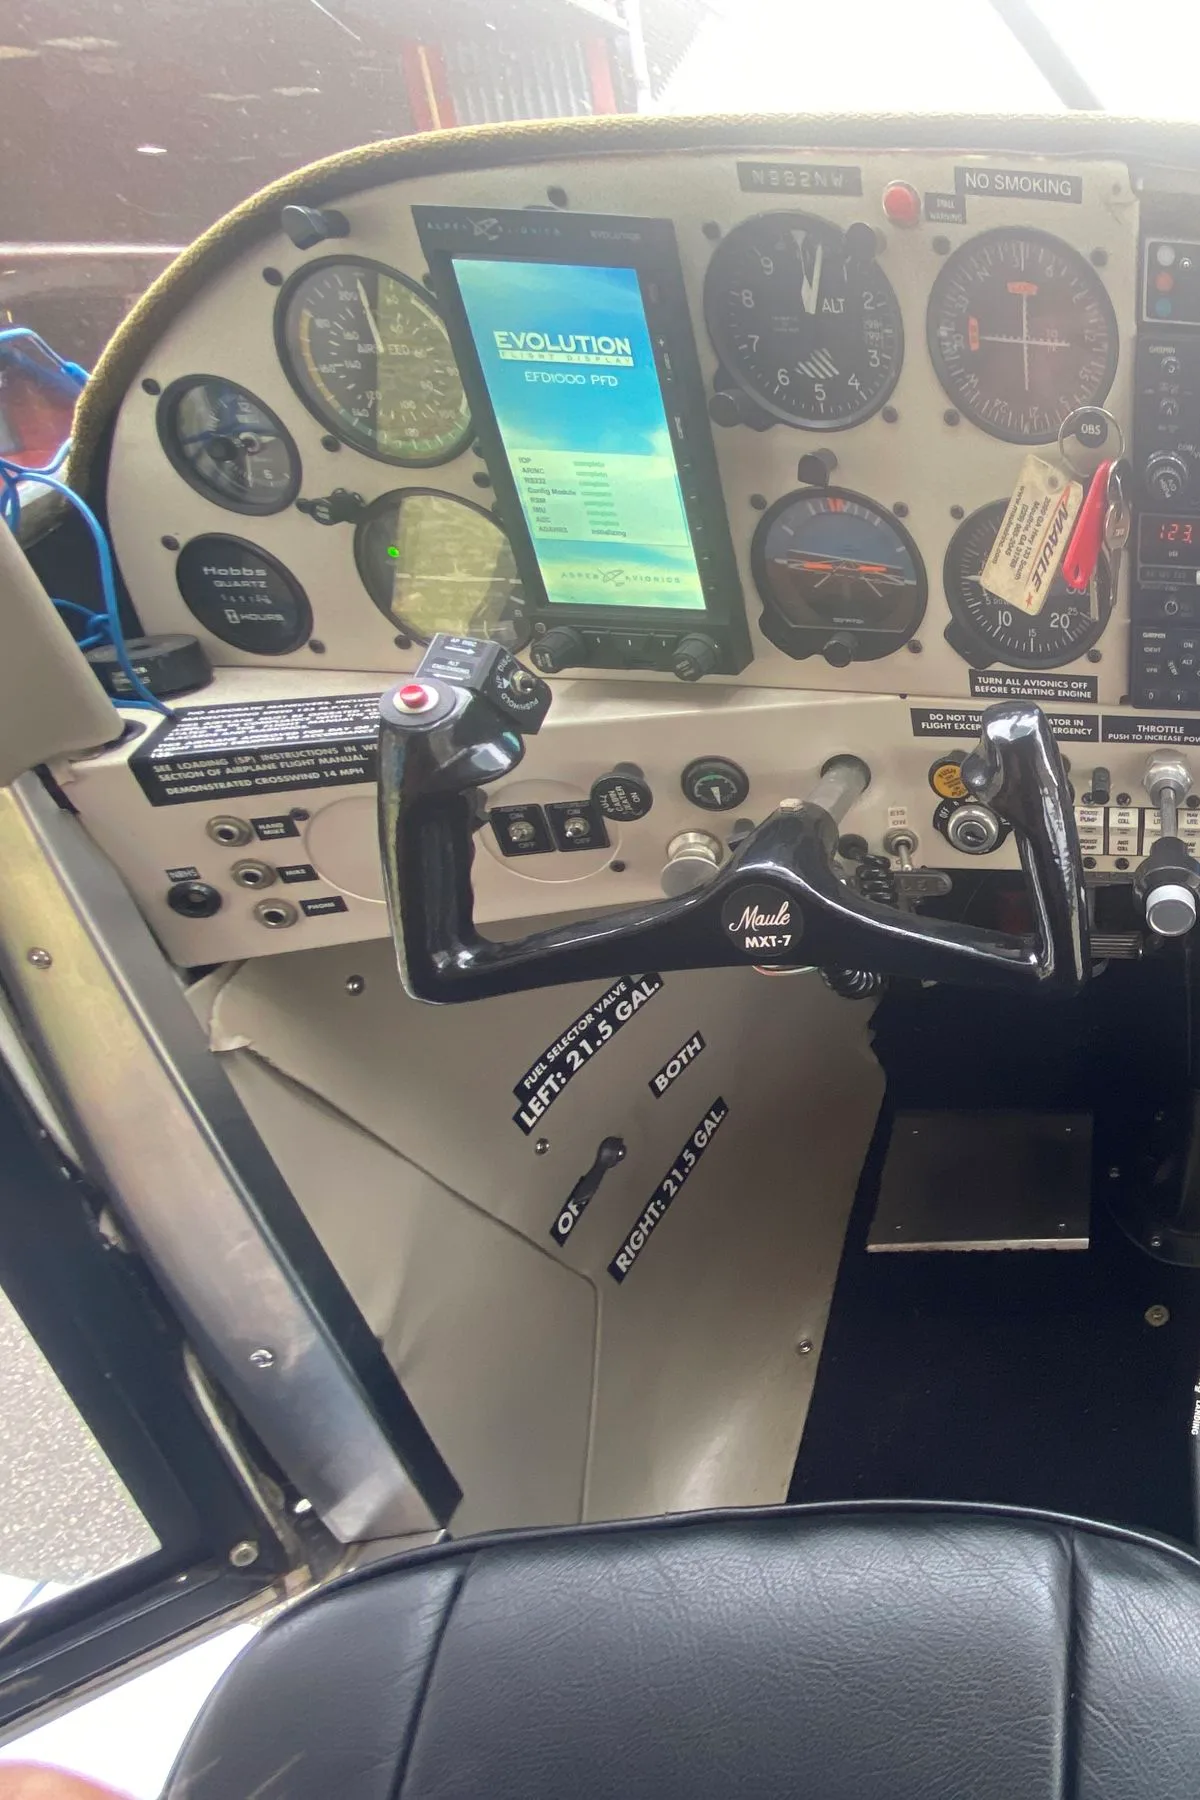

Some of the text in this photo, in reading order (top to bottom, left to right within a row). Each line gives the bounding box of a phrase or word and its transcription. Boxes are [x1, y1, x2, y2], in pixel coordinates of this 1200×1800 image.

[965, 173, 1072, 196] NO SMOKING
[760, 256, 774, 275] 9
[741, 289, 755, 309] 8
[822, 298, 845, 314] ALT
[861, 291, 875, 310] 2
[493, 330, 632, 356] EVOLUTION
[747, 334, 760, 352] 7
[501, 351, 631, 365] FLIGHT DISPLAY
[867, 349, 881, 368] 3
[524, 371, 619, 387] EFD1000 PFD
[777, 368, 790, 386] 6
[848, 373, 861, 390] 4
[814, 383, 826, 401] 5
[1081, 423, 1101, 436] OBS
[1031, 502, 1070, 593] MAULE
[202, 566, 268, 576] Hobbs
[213, 580, 268, 588] QUARTZ
[240, 613, 285, 621] HOURS
[999, 610, 1013, 627] 10
[1050, 612, 1070, 629] 20
[1028, 628, 1037, 637] 15
[977, 676, 1088, 690] TURN ALL AVIONICS OFF
[974, 686, 1092, 699] BEFORE STARTING ENGINE
[921, 722, 951, 730] FLIGHT
[929, 713, 966, 723] DO NOT
[1073, 719, 1084, 727] IN
[1108, 733, 1130, 741] PUSH
[1144, 735, 1182, 743] INCREASE
[1136, 724, 1185, 735] THROTTLE
[153, 764, 172, 773] SEE
[176, 758, 229, 771] LOADING
[260, 747, 339, 762] INSTRUCTIONS
[343, 745, 358, 753] IN
[158, 771, 205, 783] SECTION
[206, 768, 222, 777] OF
[225, 762, 278, 775] AIRPLANE
[280, 759, 315, 769] FLIGHT
[165, 767, 365, 795] DEMONSTRATED CROSSWIND 14 MPH
[939, 806, 950, 819] OFF
[1117, 817, 1130, 825] COLL
[258, 822, 285, 830] HAND
[728, 901, 791, 933] Maule
[745, 934, 792, 949] MXT-7
[524, 981, 628, 1090] FUEL SELECTOR VALVE
[520, 978, 661, 1128] LEFT: 21.5 GAL.
[654, 1037, 702, 1093] BOTH
[616, 1107, 726, 1273] RIGHT: 21.5 GAL.
